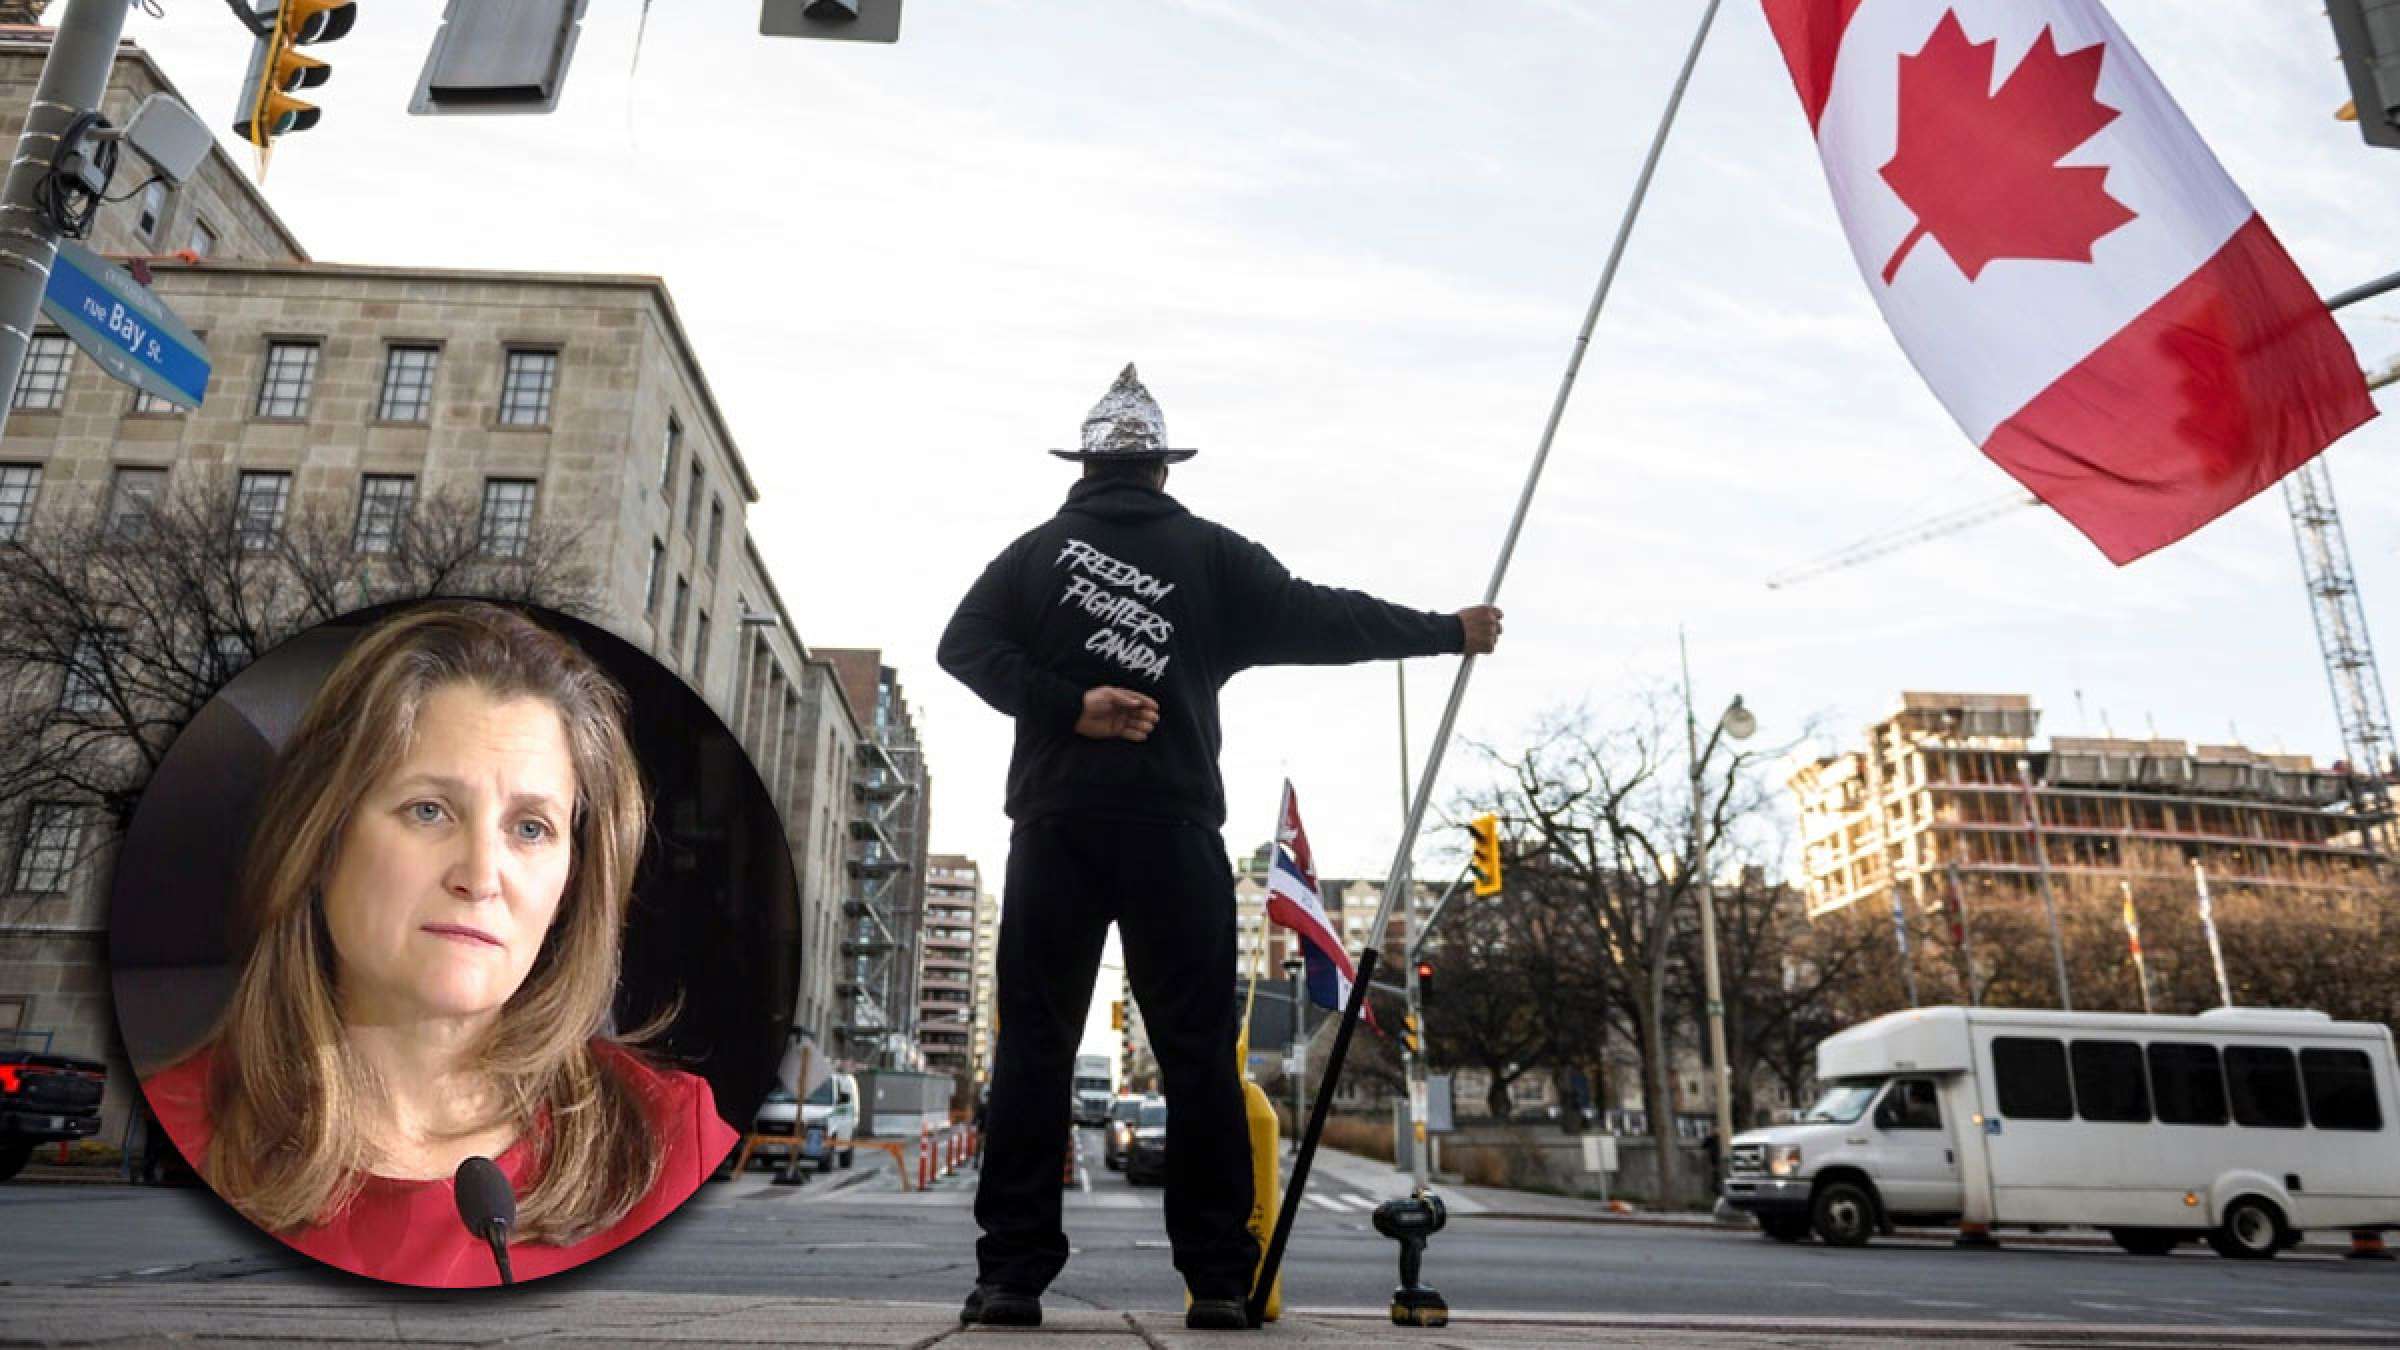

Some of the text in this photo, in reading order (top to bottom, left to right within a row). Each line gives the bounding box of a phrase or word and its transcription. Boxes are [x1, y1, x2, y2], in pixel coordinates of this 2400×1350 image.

[84, 296, 106, 321] rue
[109, 303, 147, 353] Bay
[1055, 538, 1176, 604] FREEDOM
[1059, 575, 1174, 643] FIGHTERS
[1086, 628, 1171, 681] CANADA
